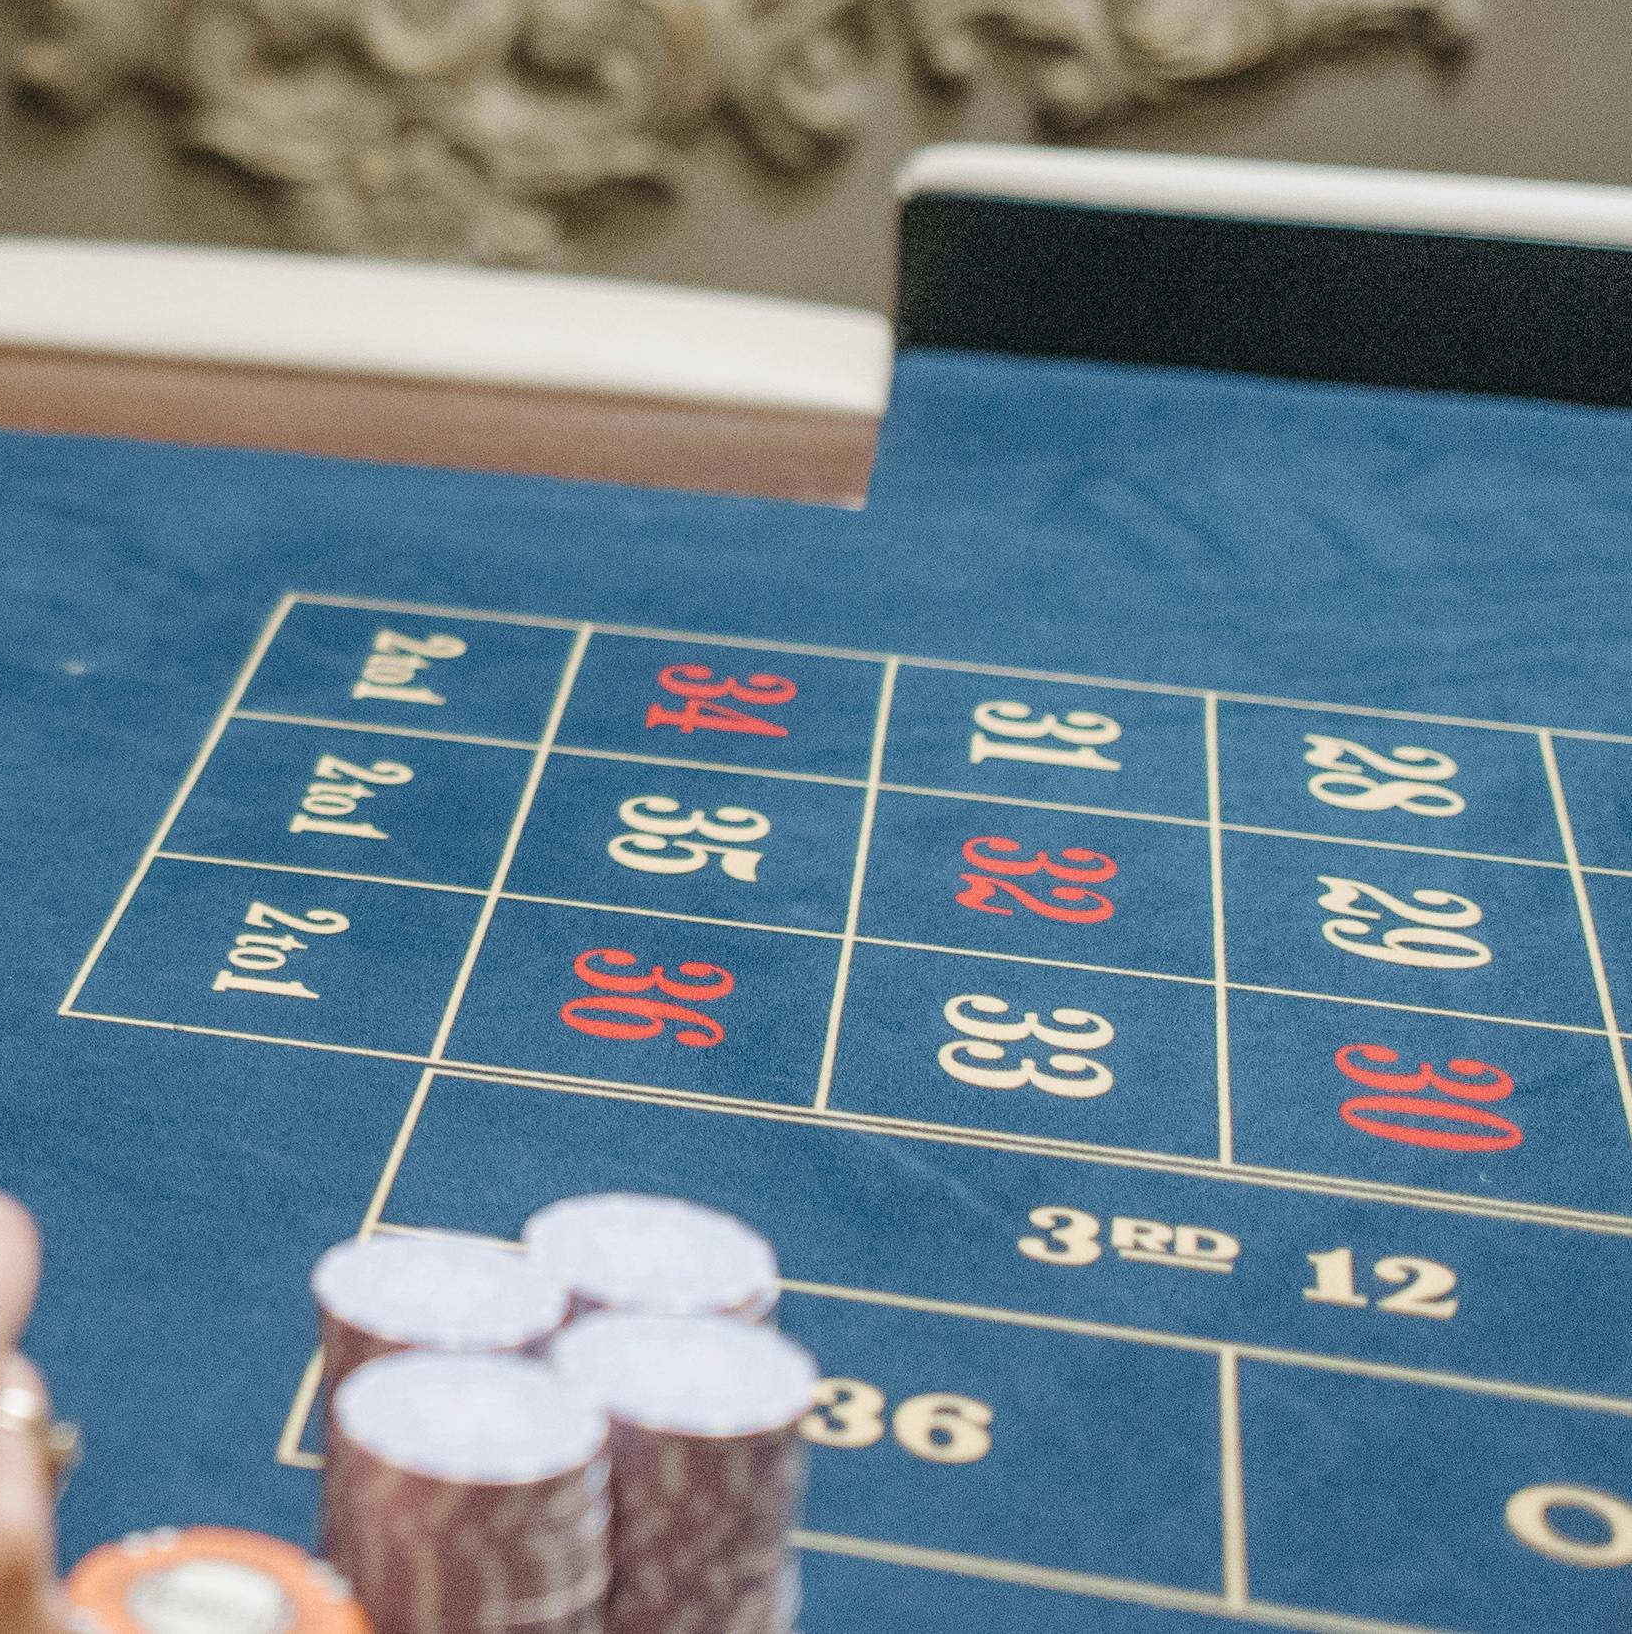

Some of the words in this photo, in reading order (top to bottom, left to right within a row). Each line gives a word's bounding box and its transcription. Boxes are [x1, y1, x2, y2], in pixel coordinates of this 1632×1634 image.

[645, 663, 798, 738] 34
[969, 700, 1123, 772] 31
[1303, 733, 1467, 818] 28
[607, 795, 772, 883] 35
[954, 835, 1119, 925] 32
[1316, 875, 1493, 970] 29
[560, 947, 736, 1048] 36
[937, 993, 1116, 1099] 33
[1334, 1043, 1524, 1153] 30
[1017, 1205, 1241, 1274] 3RD
[1302, 1247, 1459, 1320] 12
[799, 1376, 994, 1465] 36
